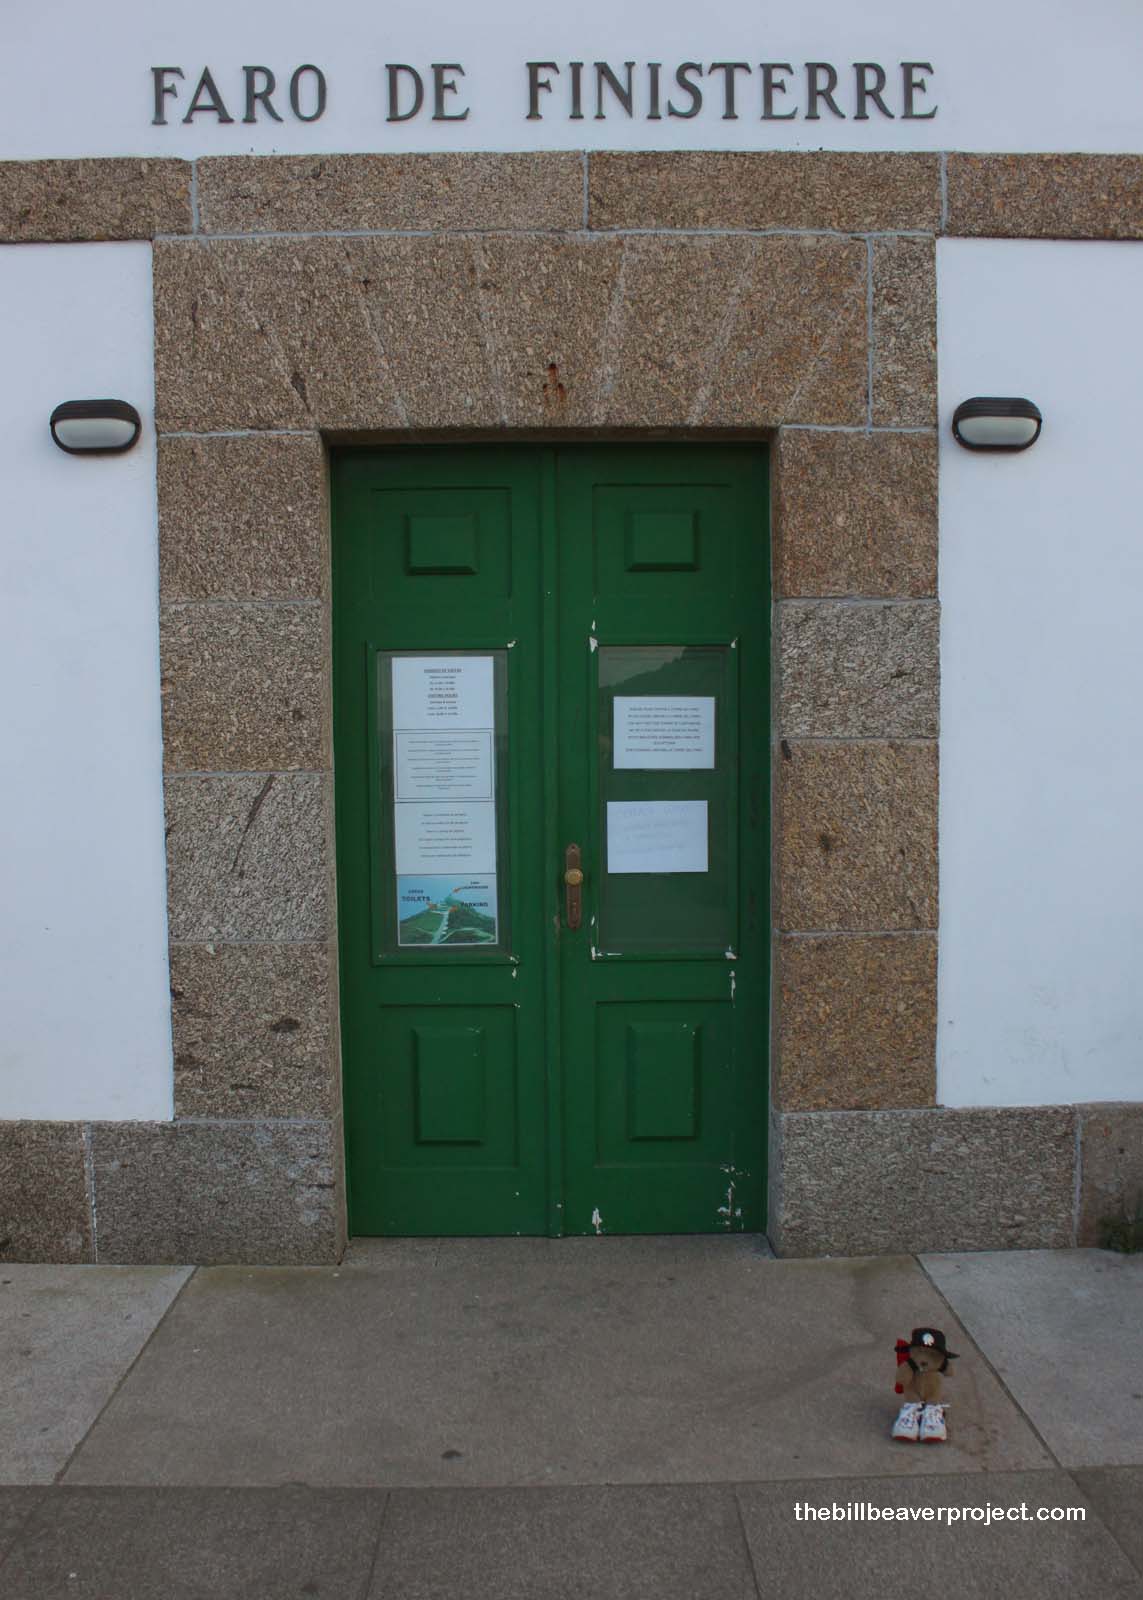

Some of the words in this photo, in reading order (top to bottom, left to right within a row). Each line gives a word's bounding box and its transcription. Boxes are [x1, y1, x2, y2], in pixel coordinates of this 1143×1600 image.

[151, 64, 327, 125] FARO
[385, 63, 470, 122] DE
[525, 62, 938, 120] FINISTERRE
